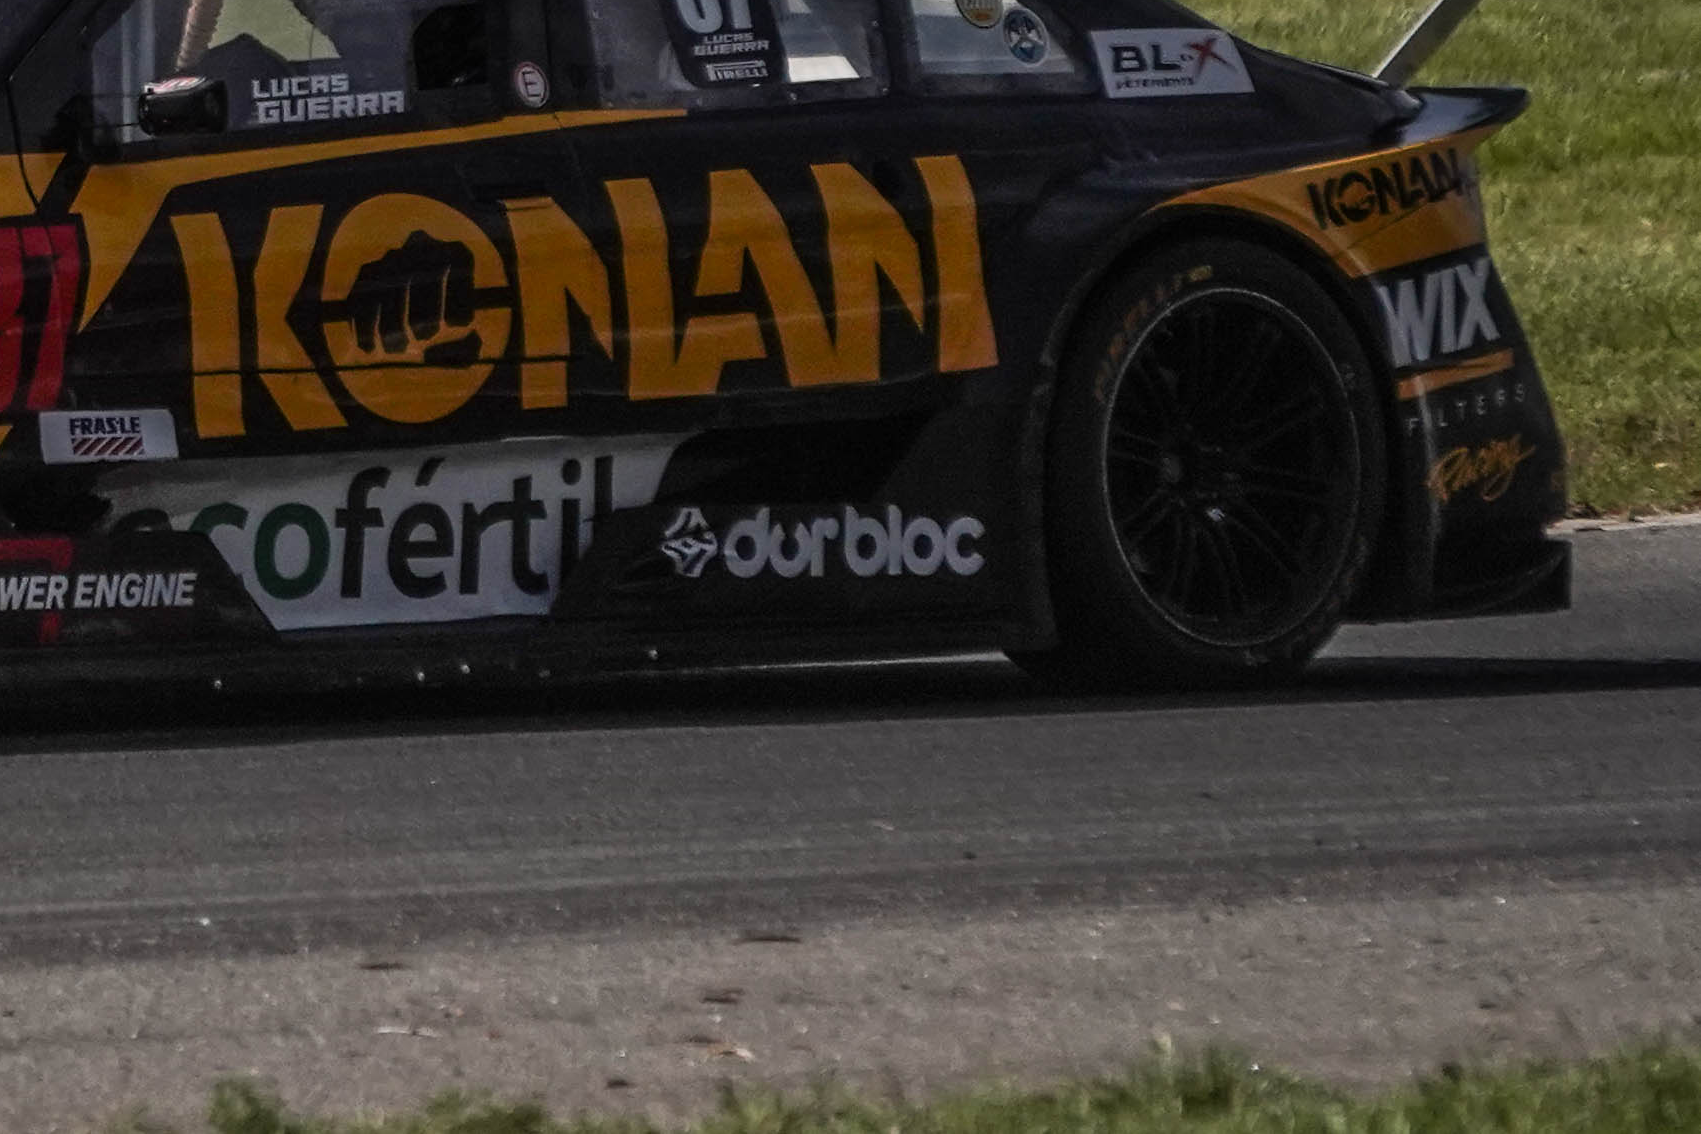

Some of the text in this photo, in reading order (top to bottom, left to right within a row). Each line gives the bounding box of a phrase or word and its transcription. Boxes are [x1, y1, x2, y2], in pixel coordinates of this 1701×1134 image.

[694, 40, 770, 56] GUERRA
[702, 32, 754, 45] LUCAS
[251, 73, 350, 99] LUCAS
[706, 60, 769, 82] PIRELLI
[257, 90, 406, 125] GUERRA
[171, 154, 998, 440] KONAN
[1370, 256, 1502, 368] WIX
[1405, 383, 1527, 437] FLTERS
[111, 455, 614, 600] oférti
[723, 503, 986, 578] durbloc
[73, 572, 198, 610] ENGINE
